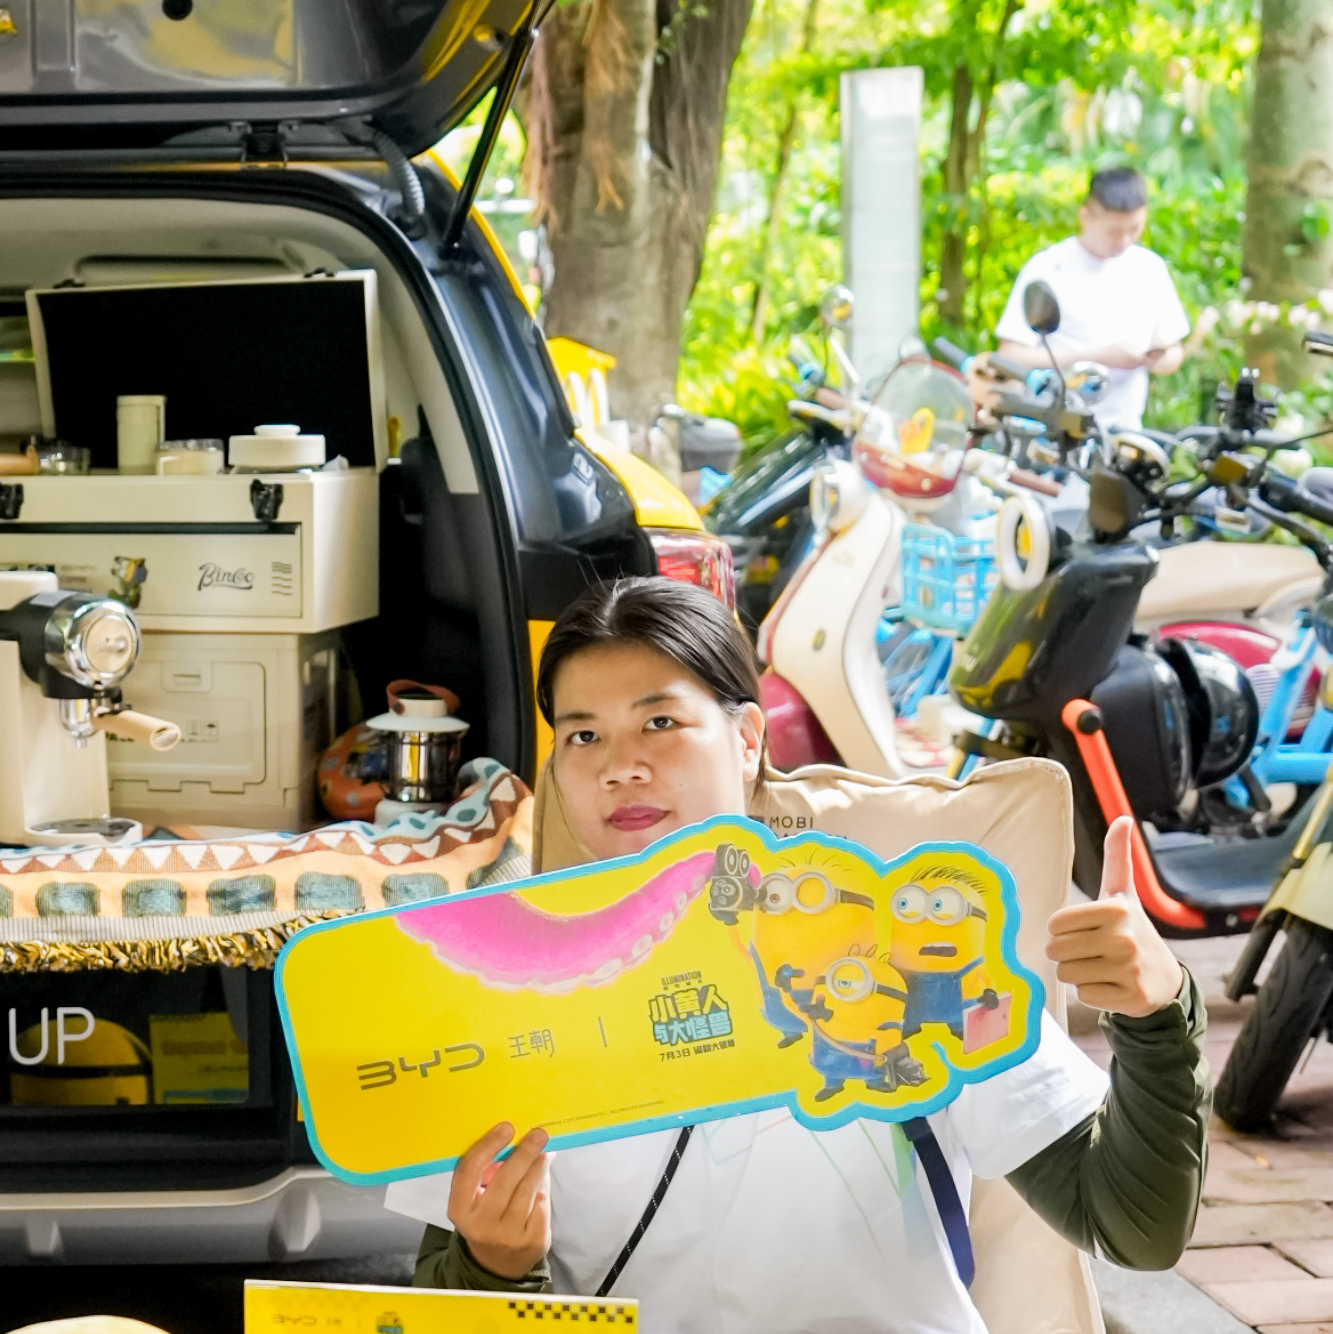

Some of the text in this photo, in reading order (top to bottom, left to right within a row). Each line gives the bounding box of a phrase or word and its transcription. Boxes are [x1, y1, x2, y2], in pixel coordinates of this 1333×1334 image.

[769, 816, 814, 829] MOBI
[661, 970, 702, 986] ILLUMINATION
[650, 984, 729, 1023] 小黄人
[8, 1006, 96, 1066] UP
[508, 1028, 556, 1058] 王朝
[653, 1010, 732, 1046] 与大怪兽
[356, 1043, 485, 1090] BYD
[659, 1047, 691, 1061] 7月3日
